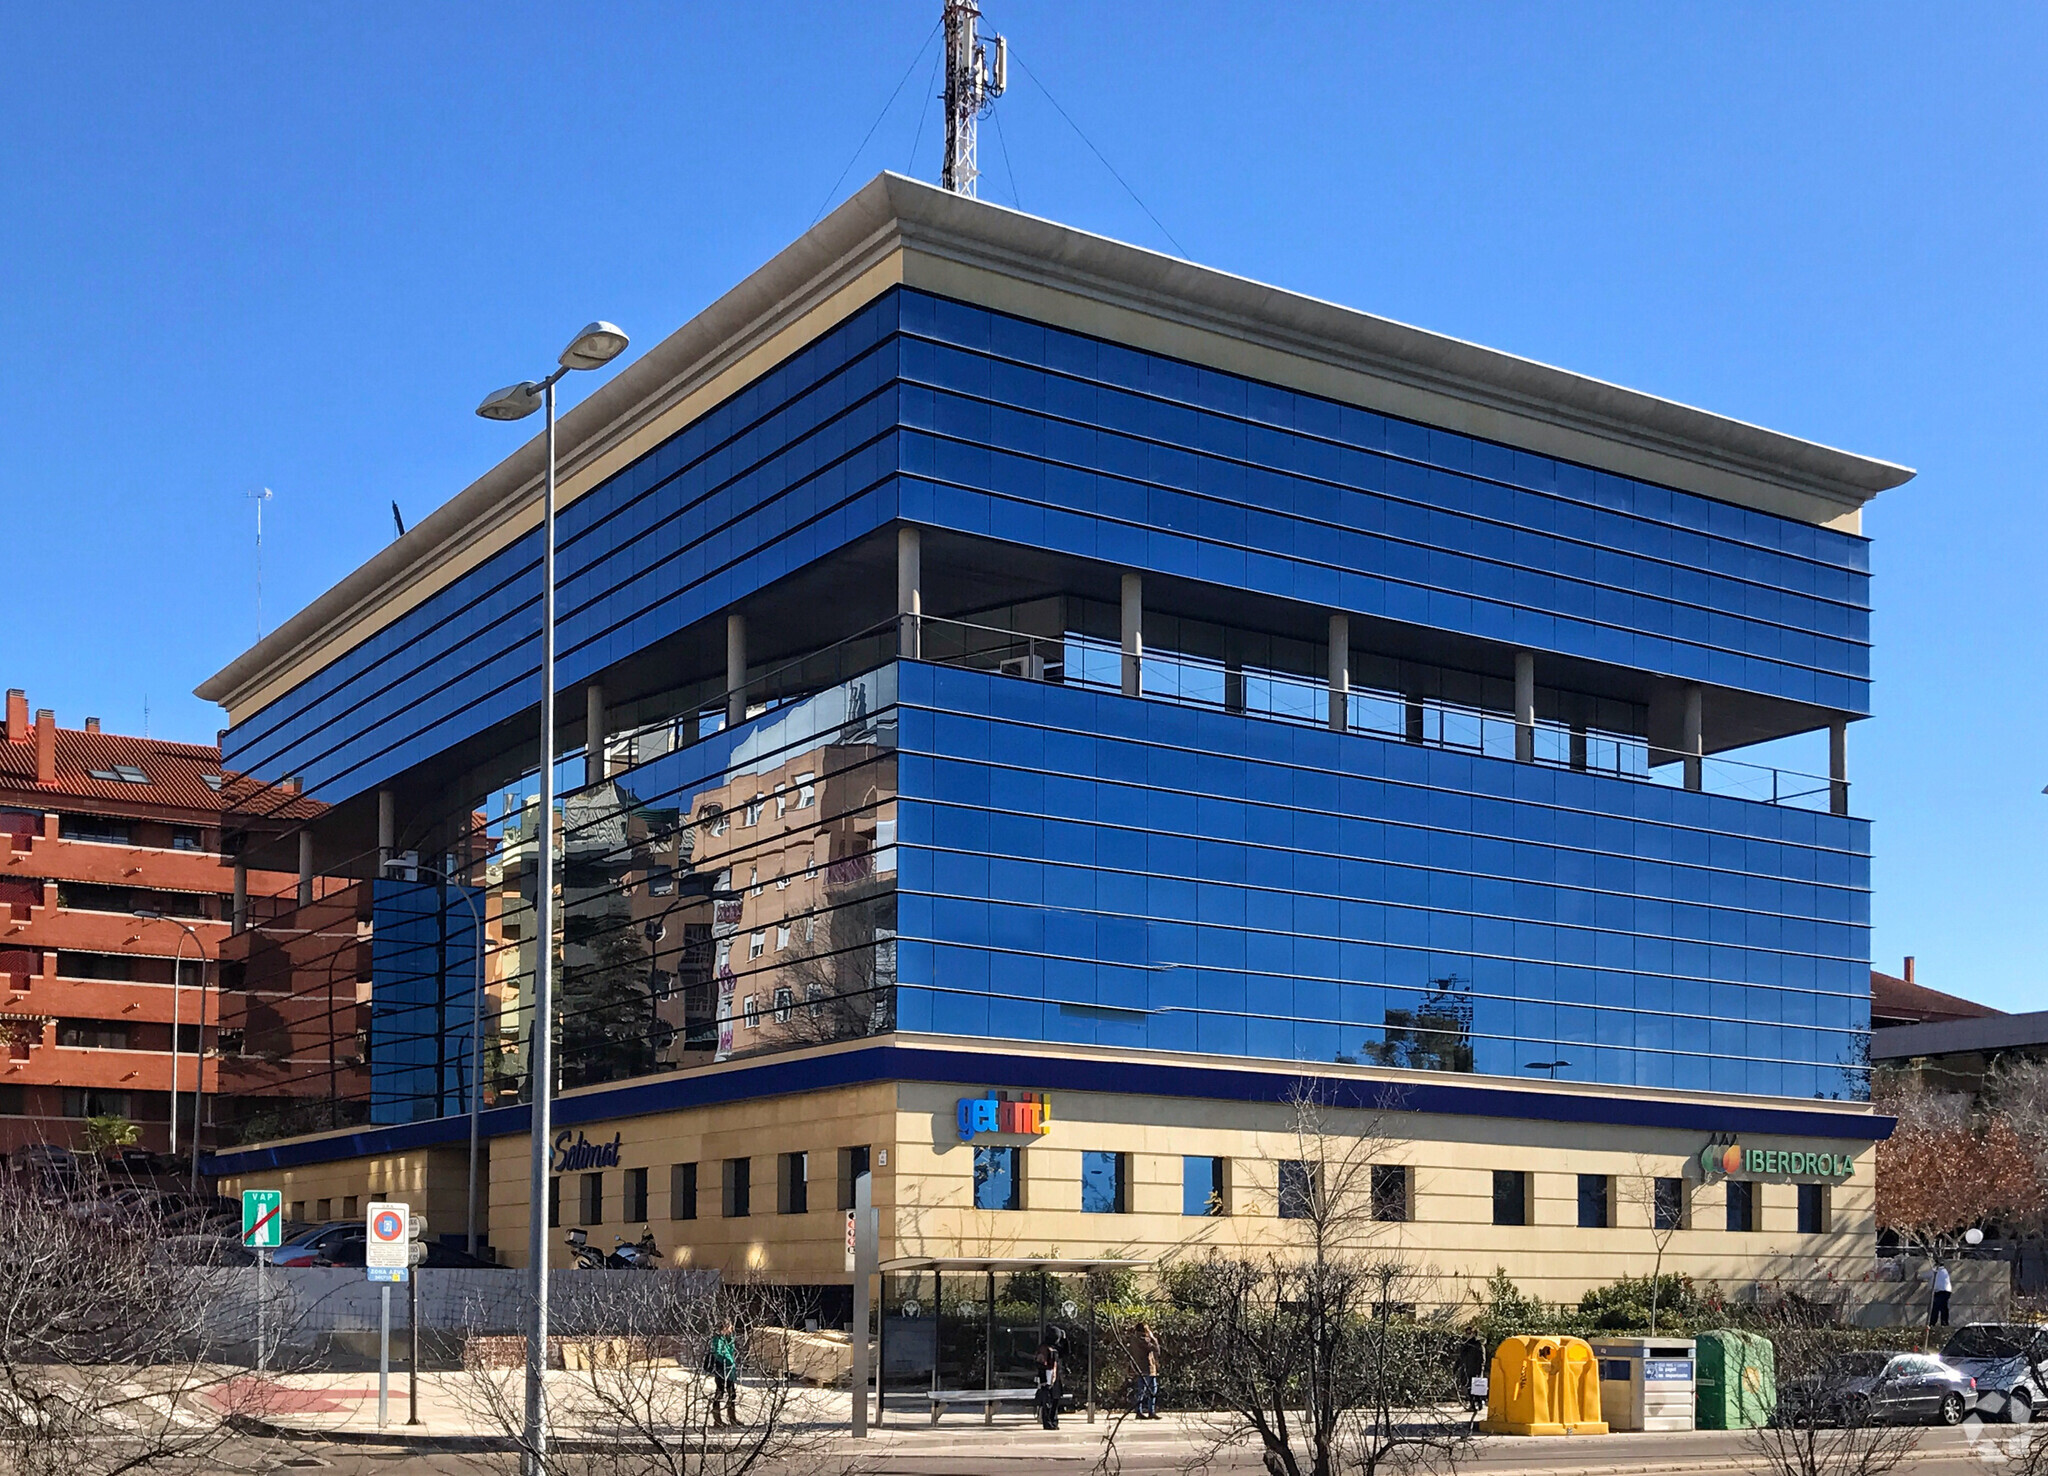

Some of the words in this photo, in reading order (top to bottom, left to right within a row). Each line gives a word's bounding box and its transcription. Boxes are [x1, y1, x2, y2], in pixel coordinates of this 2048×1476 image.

[554, 1130, 622, 1172] Solimat
[1745, 1149, 1856, 1177] IBERDROLA
[252, 1193, 273, 1201] VAP
